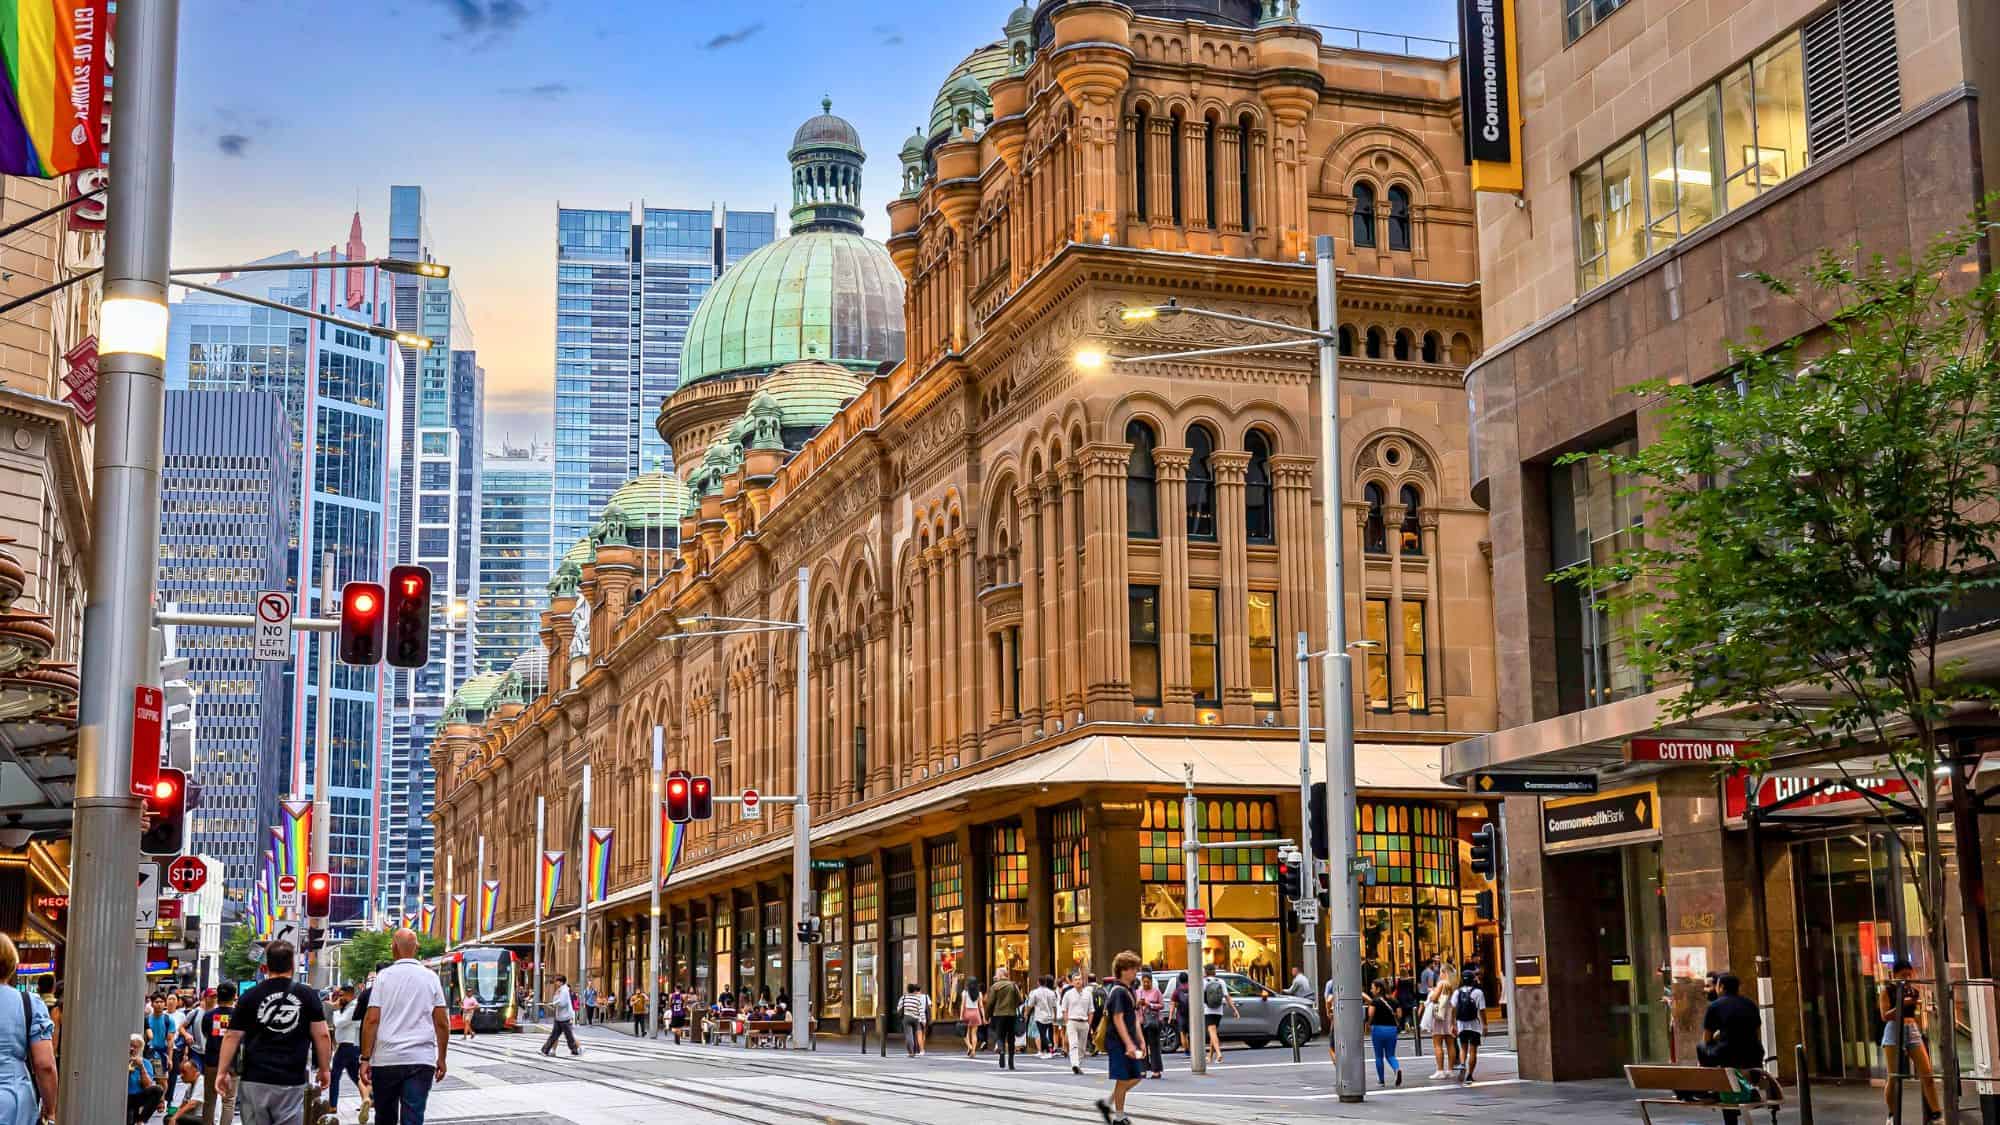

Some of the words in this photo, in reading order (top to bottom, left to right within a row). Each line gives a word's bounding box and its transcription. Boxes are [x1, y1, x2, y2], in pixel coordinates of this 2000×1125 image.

[74, 7, 94, 41] CITY
[73, 44, 92, 62] OF
[262, 625, 283, 636] NO
[259, 639, 285, 647] LEFT
[259, 648, 286, 656] TURN
[144, 694, 153, 706] NO
[136, 707, 160, 722] STOPPING
[1659, 742, 1713, 760] COTTON
[1716, 743, 1735, 758] ON
[1549, 808, 1625, 833] CommonwealthBank
[172, 868, 204, 881] STOP
